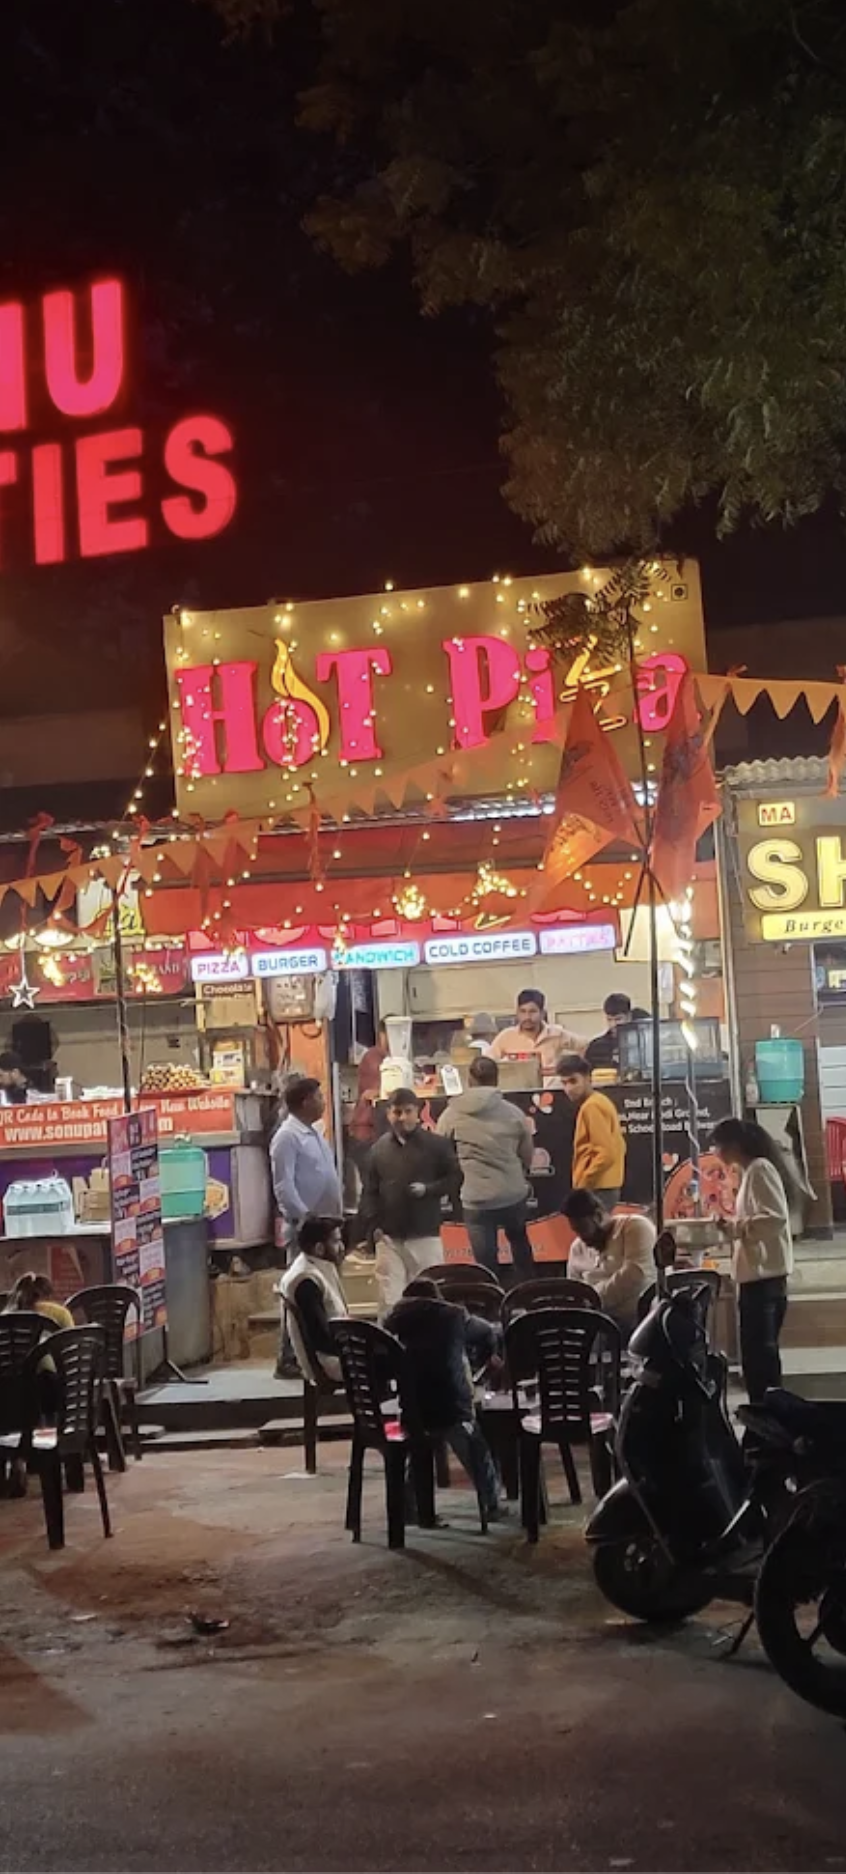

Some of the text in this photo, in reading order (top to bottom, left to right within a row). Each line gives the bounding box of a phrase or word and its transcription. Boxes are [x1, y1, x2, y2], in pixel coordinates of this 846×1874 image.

[761, 806, 792, 822] MA
[429, 938, 531, 958] COLD COFFEE
[197, 960, 241, 975] PIZZA
[258, 955, 318, 971] BURGER
